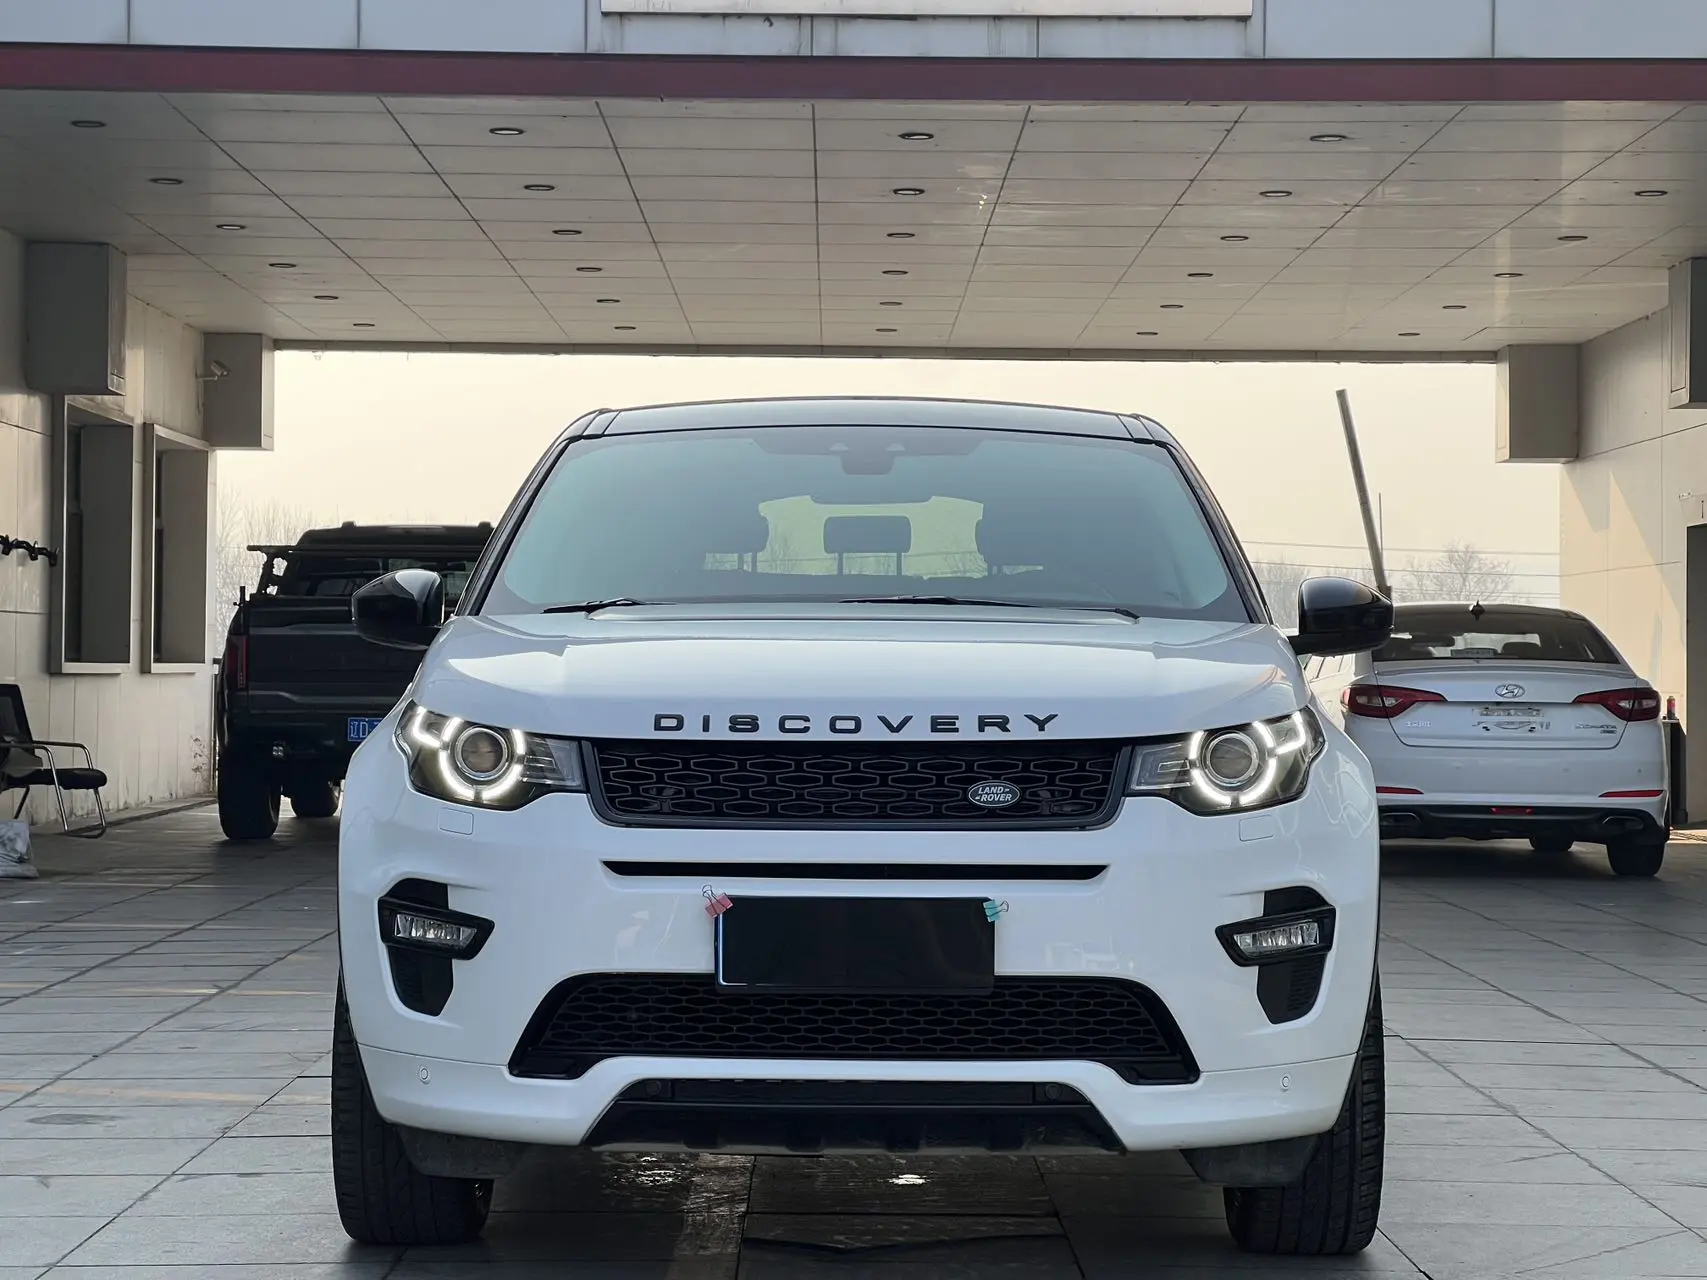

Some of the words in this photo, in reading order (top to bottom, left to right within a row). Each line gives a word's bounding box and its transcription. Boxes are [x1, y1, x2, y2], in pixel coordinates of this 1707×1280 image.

[653, 713, 1059, 734] DISCOVERY
[978, 786, 1004, 794] LAND
[980, 793, 1012, 802] ROVER
